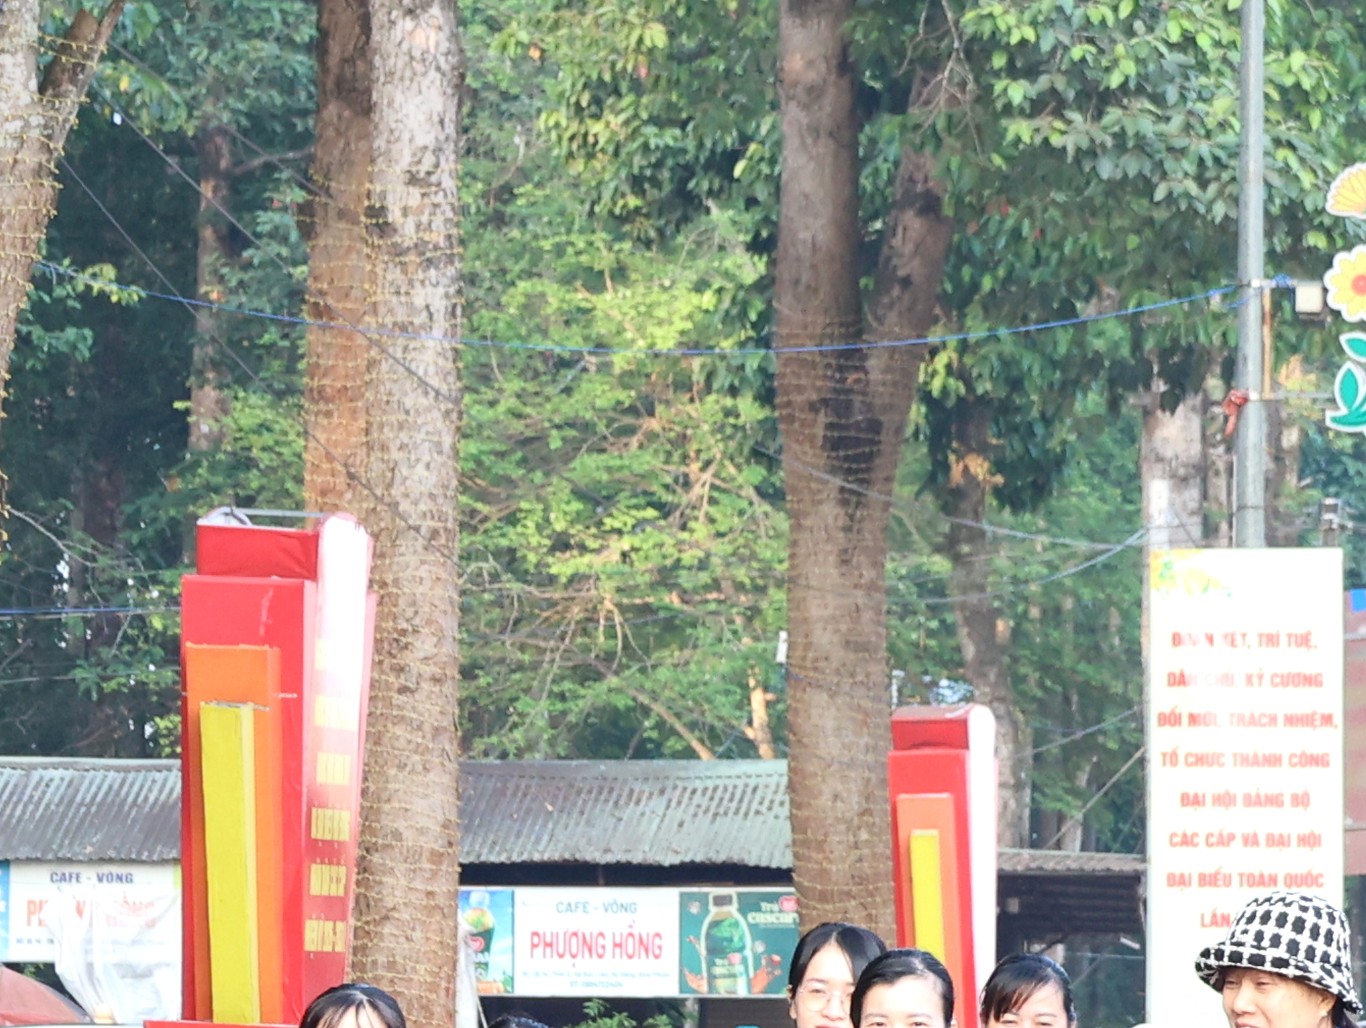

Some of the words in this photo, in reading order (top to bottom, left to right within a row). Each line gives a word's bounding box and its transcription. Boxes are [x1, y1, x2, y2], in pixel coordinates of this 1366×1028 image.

[50, 871, 82, 884] CAFE
[556, 900, 590, 914] CAFE
[530, 928, 607, 968] PHƯỢNG
[611, 919, 663, 960] HỒNG
